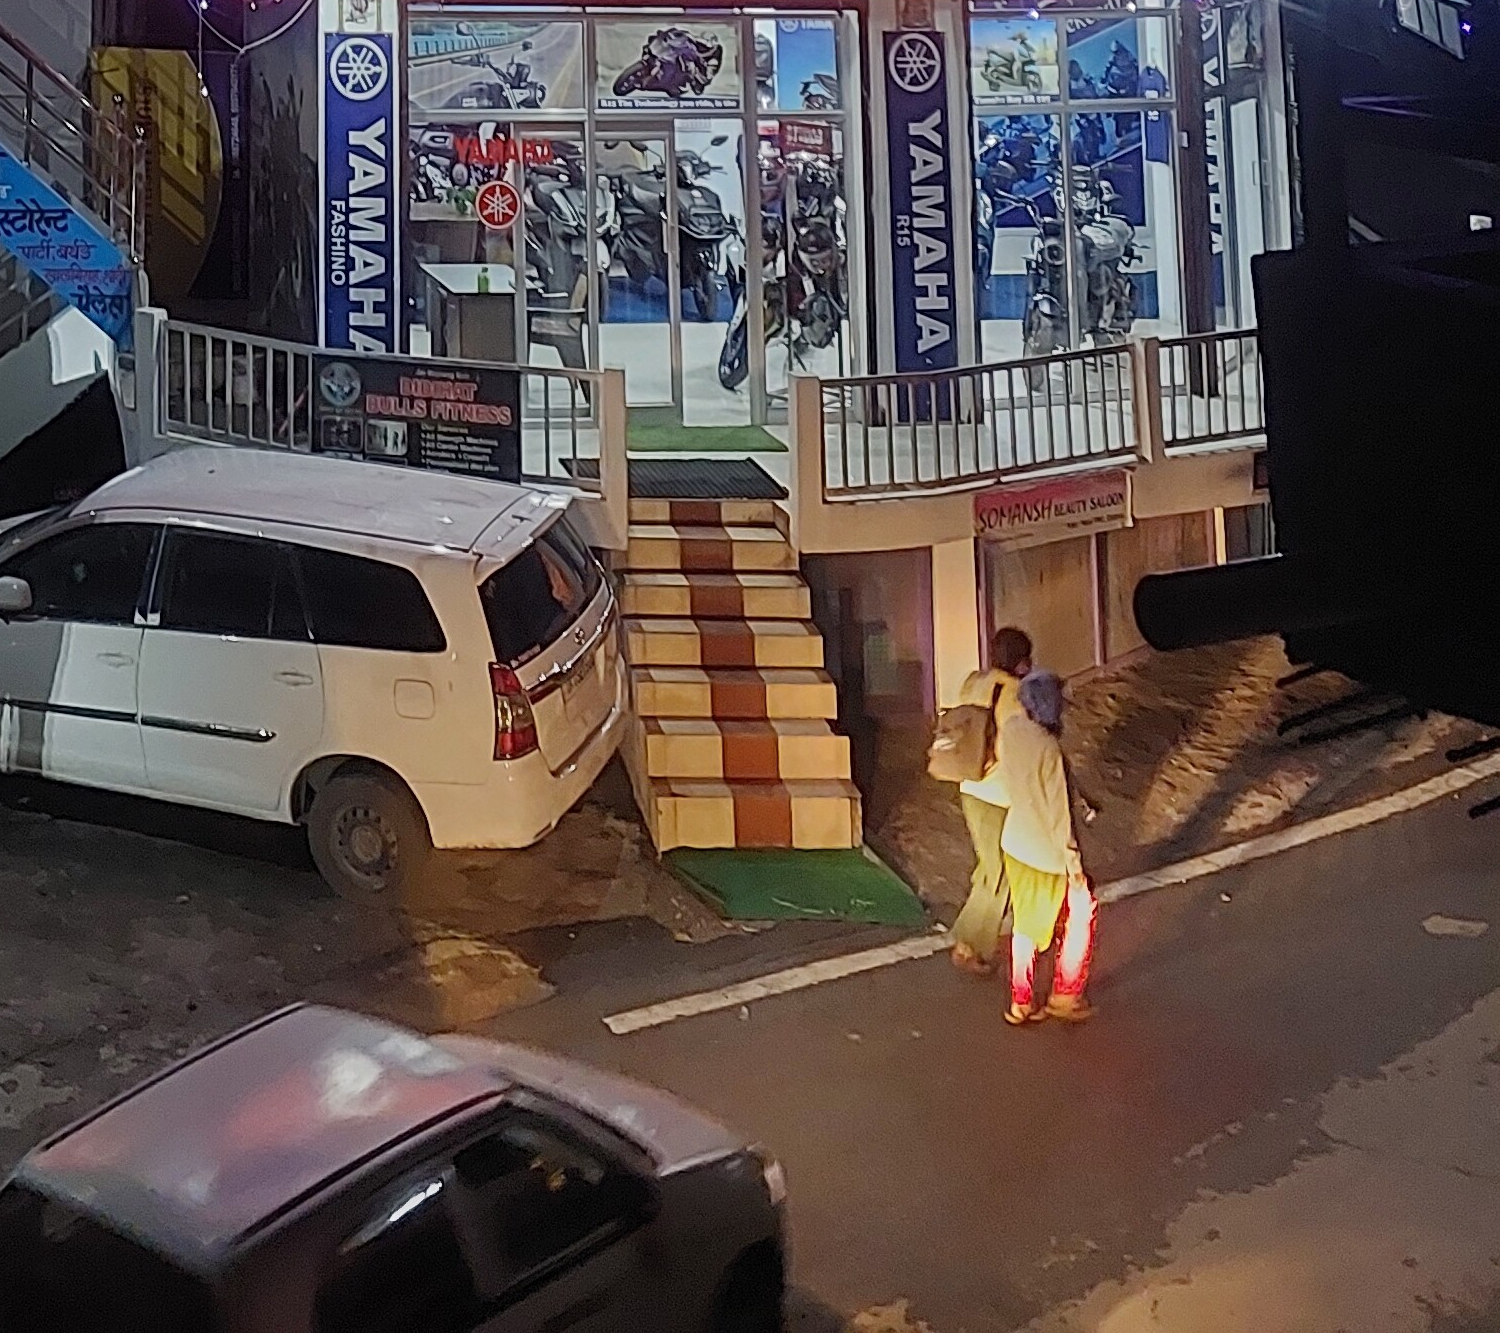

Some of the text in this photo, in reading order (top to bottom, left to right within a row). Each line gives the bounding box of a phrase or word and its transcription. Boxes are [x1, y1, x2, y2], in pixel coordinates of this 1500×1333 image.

[896, 215, 908, 247] R15
[908, 109, 951, 353] YAMAHA
[366, 395, 512, 425] BULLS FITNESS
[980, 499, 1050, 532] SOMANSH
[1054, 501, 1086, 516] BEAUTY
